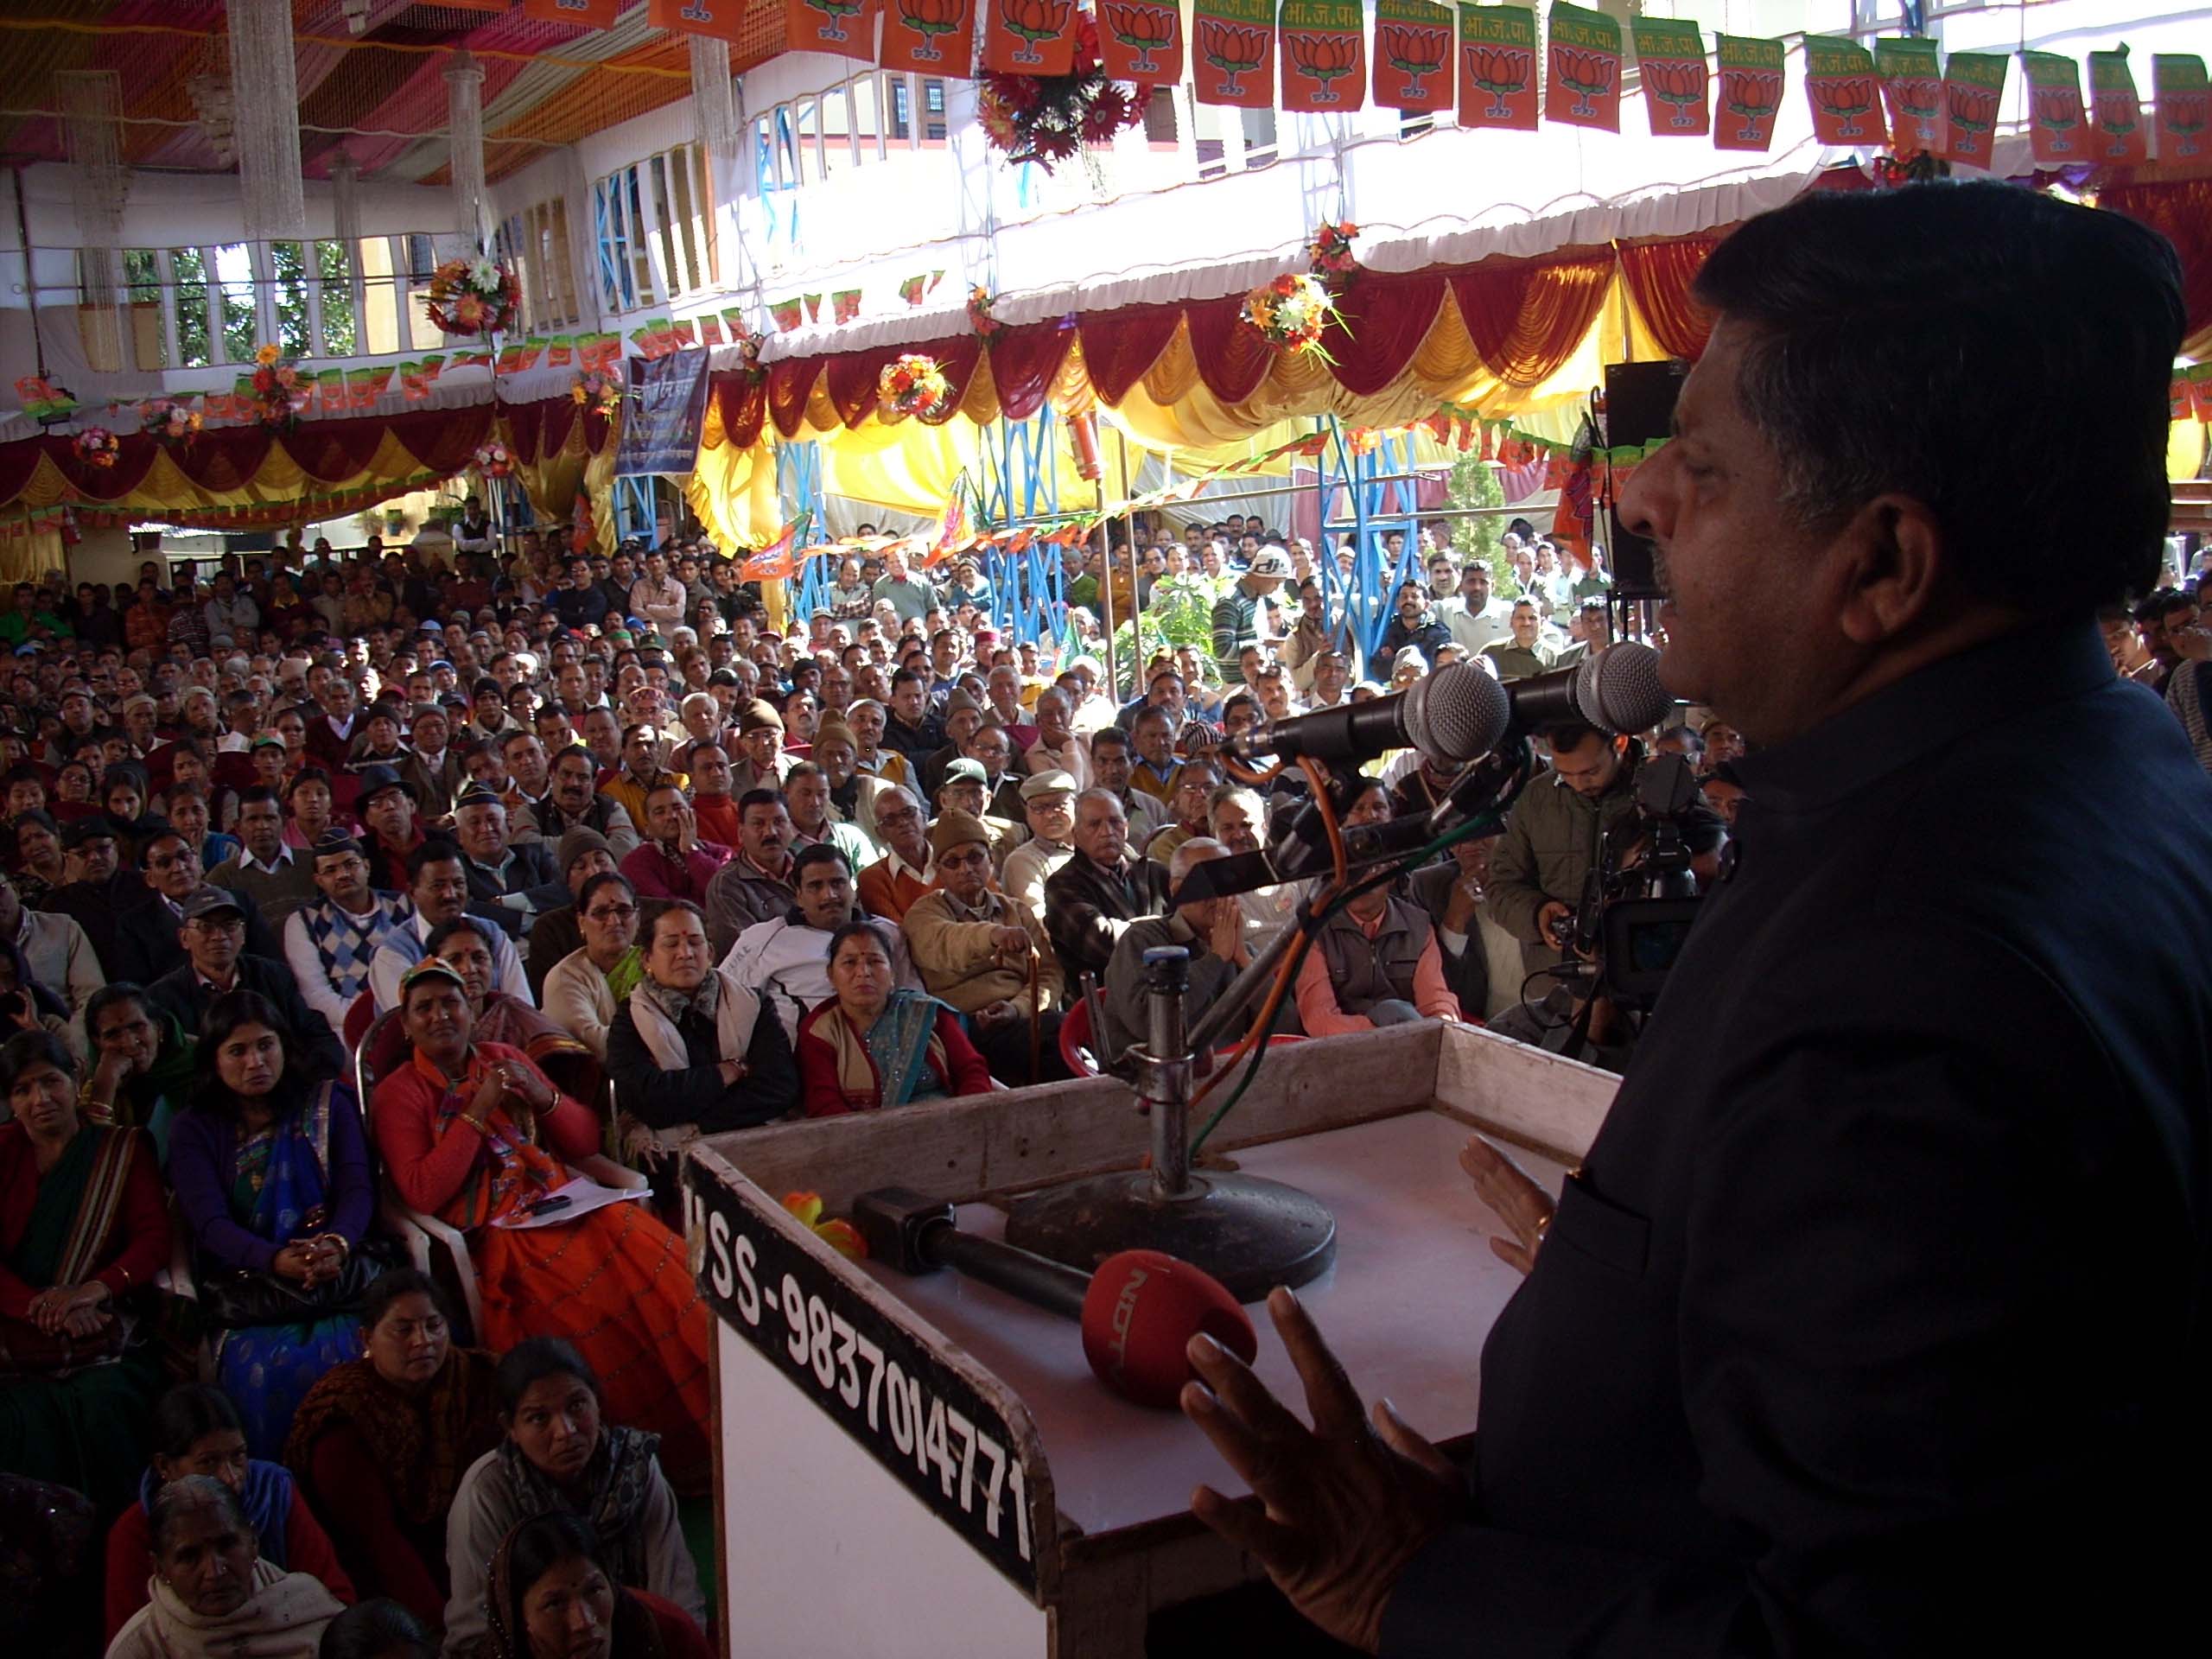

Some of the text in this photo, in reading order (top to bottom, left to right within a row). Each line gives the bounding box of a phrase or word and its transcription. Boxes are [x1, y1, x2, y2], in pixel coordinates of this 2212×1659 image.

[1285, 3, 1359, 27] भा.ज.पा.
[1465, 16, 1530, 42] भा.ज.पा.
[1552, 20, 1617, 49] भा.ज.पा.
[1638, 35, 1700, 56] भा.ज.पा.
